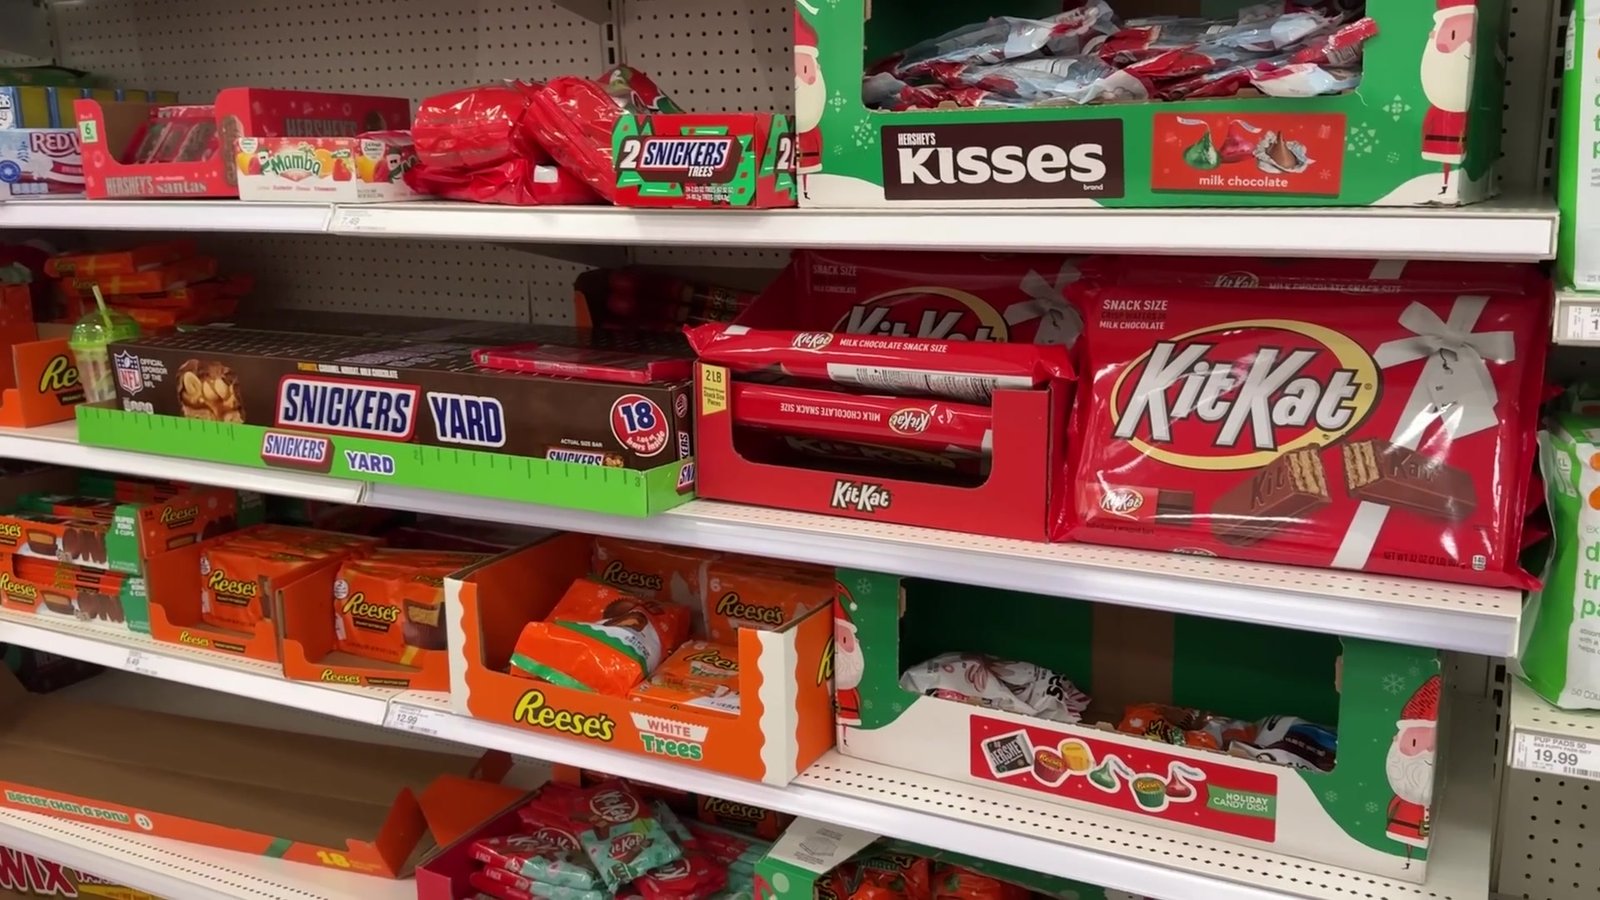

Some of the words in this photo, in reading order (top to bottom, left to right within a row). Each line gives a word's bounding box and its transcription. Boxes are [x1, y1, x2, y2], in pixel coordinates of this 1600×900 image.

[85, 123, 92, 134] 6
[898, 132, 936, 146] HERSHEY'S
[620, 140, 641, 169] 2
[643, 141, 728, 167] SNICKERS
[777, 137, 791, 169] 2
[271, 151, 321, 176] Mamba
[688, 166, 714, 177] TREES
[105, 177, 153, 196] HERSHEY'S
[157, 182, 206, 193] santas
[1083, 183, 1103, 191] brand
[1199, 175, 1226, 187] milk
[1227, 176, 1289, 189] chocolate
[841, 266, 857, 276] SIZE
[1103, 299, 1141, 311] SNACK
[1143, 300, 1168, 311] SIZE
[1099, 320, 1118, 329] MILK
[1119, 321, 1164, 330] CHOCOLATE
[792, 333, 830, 351] KitKat
[840, 338, 857, 347] MILK
[859, 340, 901, 350] CHOCOLATE
[902, 342, 929, 352] SNACK
[930, 343, 948, 353] SIZE
[140, 358, 164, 367] OFFICIAL
[39, 356, 80, 392] Re
[141, 366, 168, 375] SPONSOR
[151, 374, 162, 382] THE
[706, 369, 711, 381] 2
[712, 371, 722, 383] LB
[121, 370, 140, 389] NFL
[1112, 342, 1363, 451] KitKat
[283, 382, 411, 434] SNICKERS
[428, 393, 505, 446] YARD
[780, 402, 794, 412] SIZE
[796, 404, 820, 416] SNACK
[821, 405, 861, 420] CHOCOLATE
[619, 400, 656, 433] 18
[863, 410, 881, 422] MILK
[890, 411, 930, 432] KitKat
[560, 438, 580, 446] ACTUAL
[626, 436, 646, 451] bars
[264, 434, 325, 461] SNICKERS
[346, 451, 394, 474] YARD
[548, 451, 603, 466] SNICKERS
[831, 480, 890, 511] KitKat
[603, 561, 663, 590] Reese's
[0, 573, 37, 597] Reese's
[208, 570, 257, 597] Reese's
[709, 578, 722, 592] 6
[343, 592, 401, 622] Reese's
[717, 593, 785, 625] Reese's
[180, 632, 210, 646] Reese's
[321, 668, 361, 684] Reese's
[396, 714, 418, 725] 12.99
[513, 690, 616, 741] Reese's
[647, 719, 692, 738] WHITE
[640, 733, 703, 760] Trees
[1552, 738, 1575, 748] PADS
[1534, 748, 1578, 766] 19.99
[1213, 796, 1245, 809] CANDY
[1246, 800, 1269, 813] DISH
[1225, 792, 1269, 806] HOLIDAY
